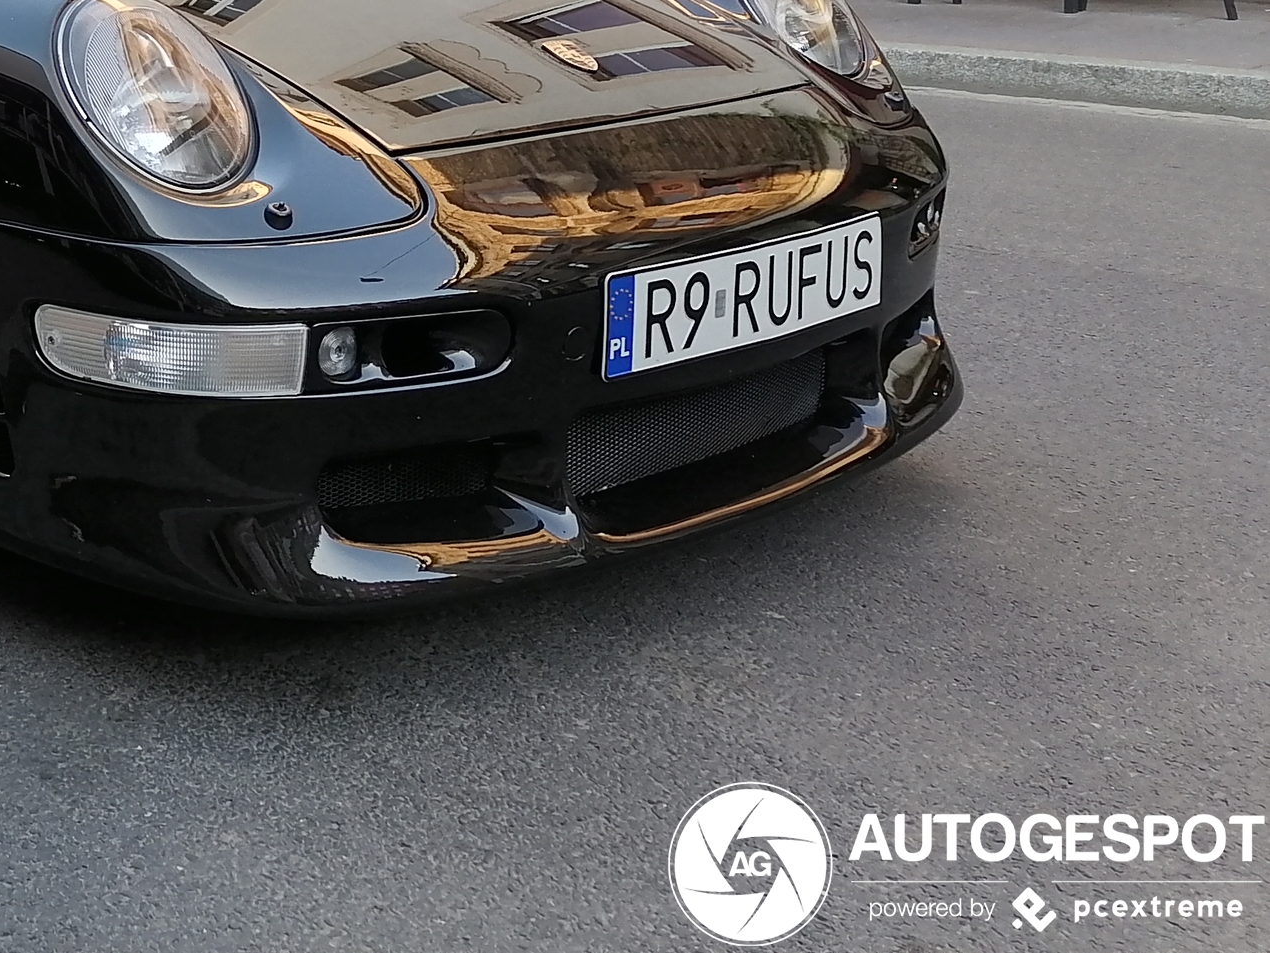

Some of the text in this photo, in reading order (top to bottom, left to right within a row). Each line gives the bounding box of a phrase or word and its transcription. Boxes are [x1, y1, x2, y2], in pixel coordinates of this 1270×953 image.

[644, 230, 874, 359] R9 RUFUS
[609, 337, 630, 360] PL
